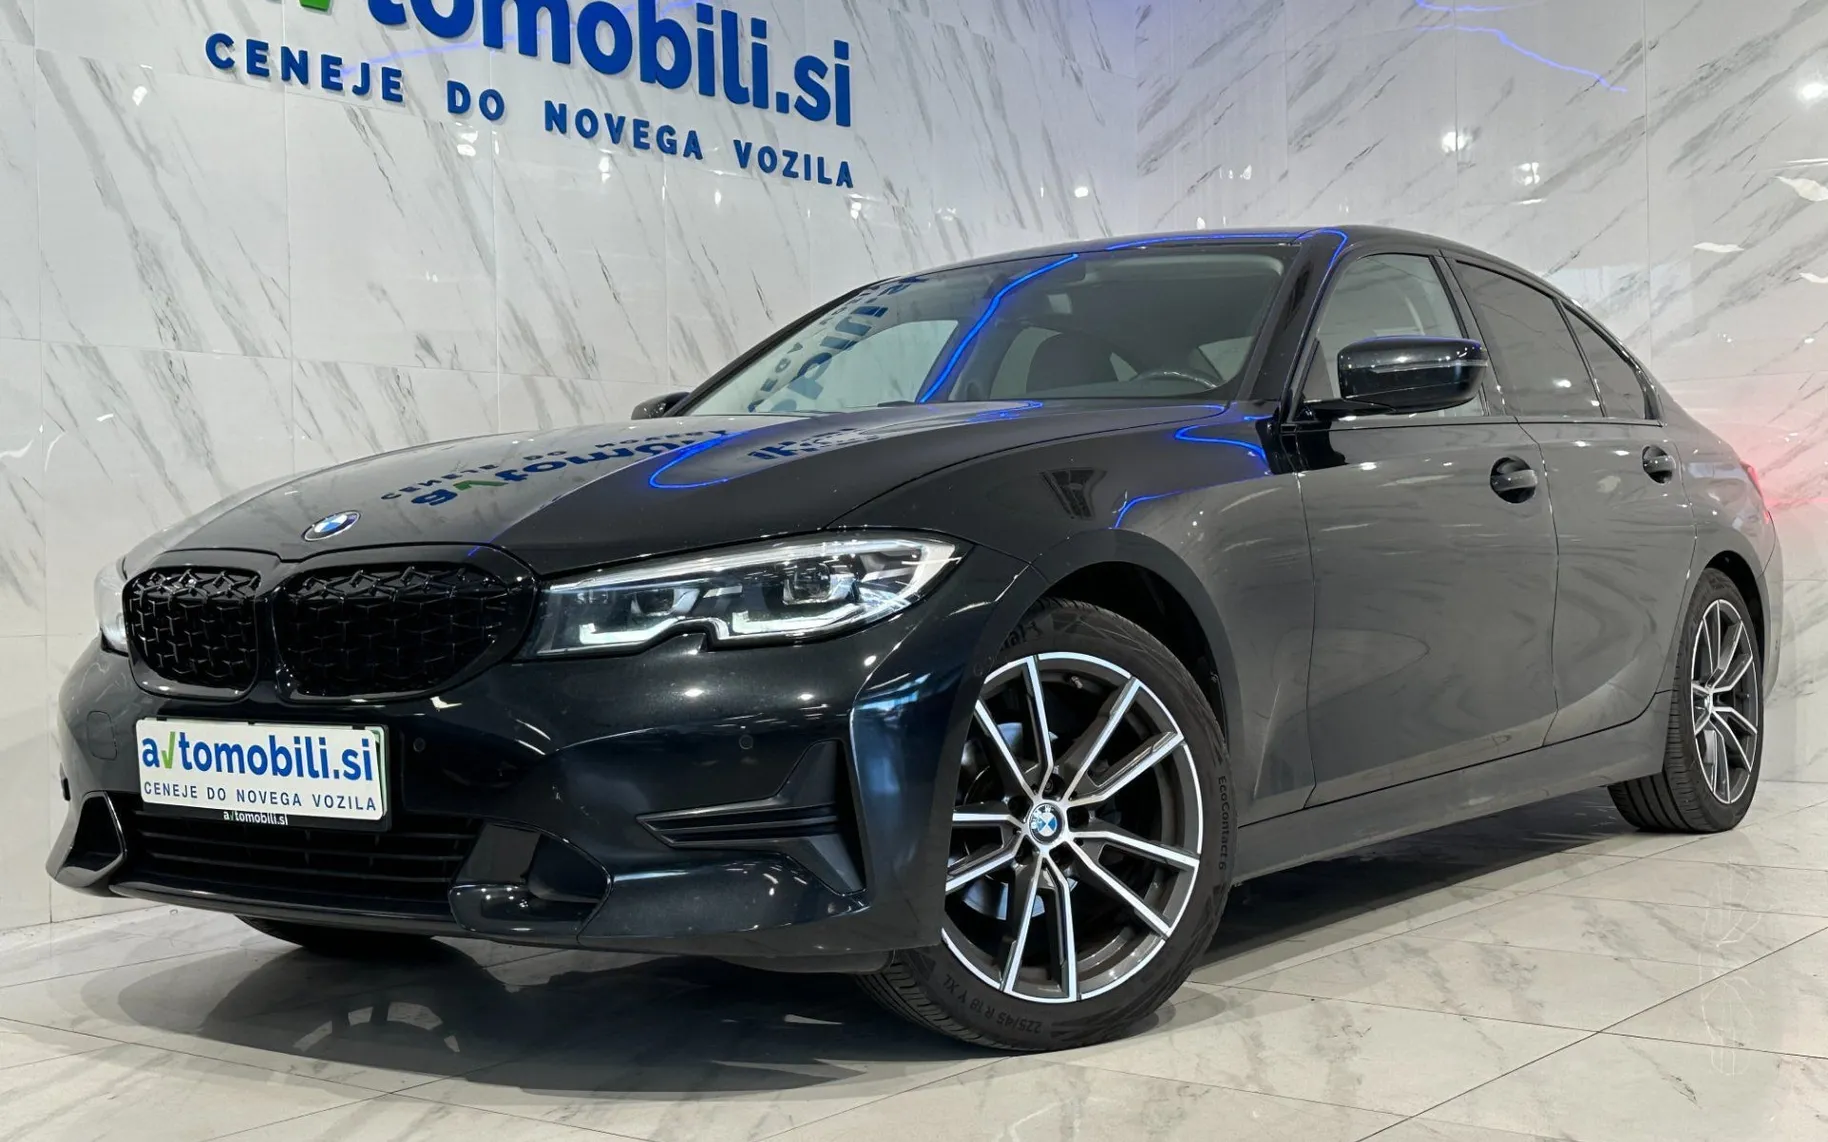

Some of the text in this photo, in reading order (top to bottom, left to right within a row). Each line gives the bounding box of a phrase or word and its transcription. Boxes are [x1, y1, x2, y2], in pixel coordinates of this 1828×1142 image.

[205, 33, 854, 188] CENEJE DO NOVEGA VOZILA
[144, 781, 376, 811] CENEJE DO NOVEGA VOZILA
[1219, 776, 1230, 870] EcoContact 6
[970, 1001, 984, 1014] 18
[985, 1007, 996, 1019] R
[999, 1013, 1042, 1034] 225/45
